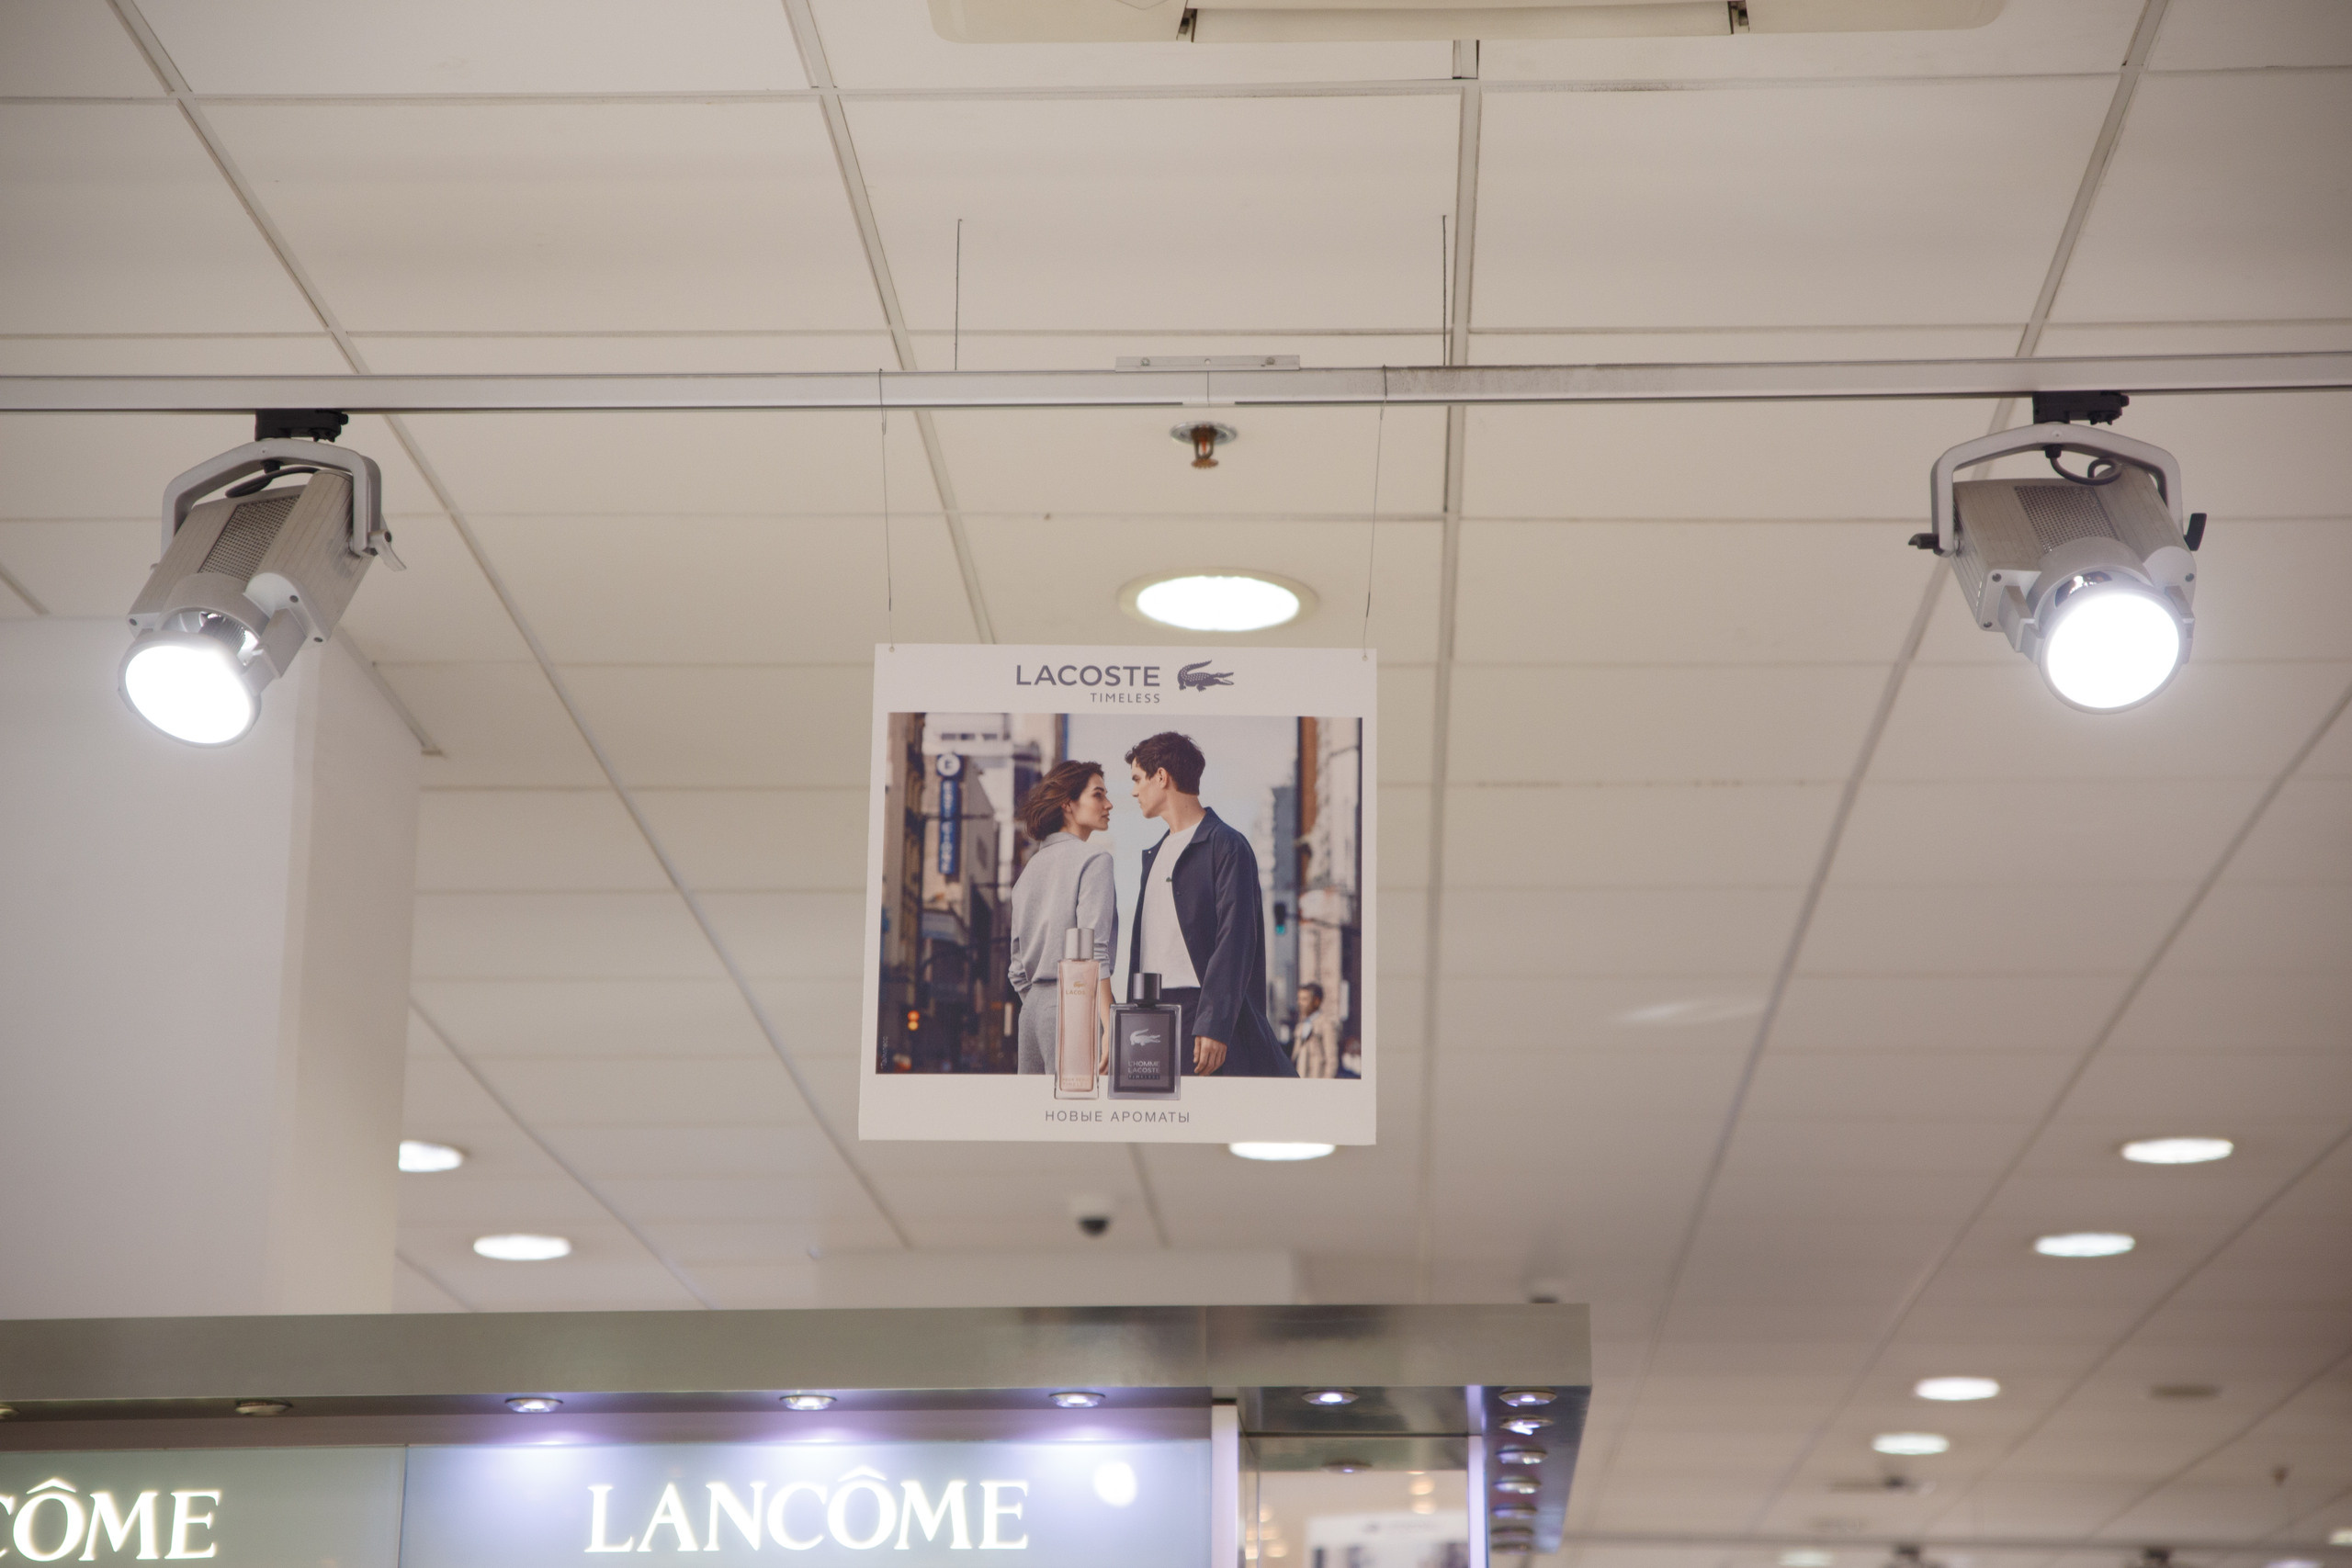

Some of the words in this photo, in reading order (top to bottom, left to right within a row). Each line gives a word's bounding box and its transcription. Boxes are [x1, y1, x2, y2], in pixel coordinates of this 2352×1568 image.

[1016, 664, 1160, 686] LACOSTE
[1090, 692, 1160, 704] TIMELESS
[1045, 1111, 1102, 1122] НОВЫЕ
[1110, 1111, 1190, 1123] АРОМАТЫ
[0, 1477, 221, 1562] ÔME
[583, 1464, 1029, 1553] LANCÔME
